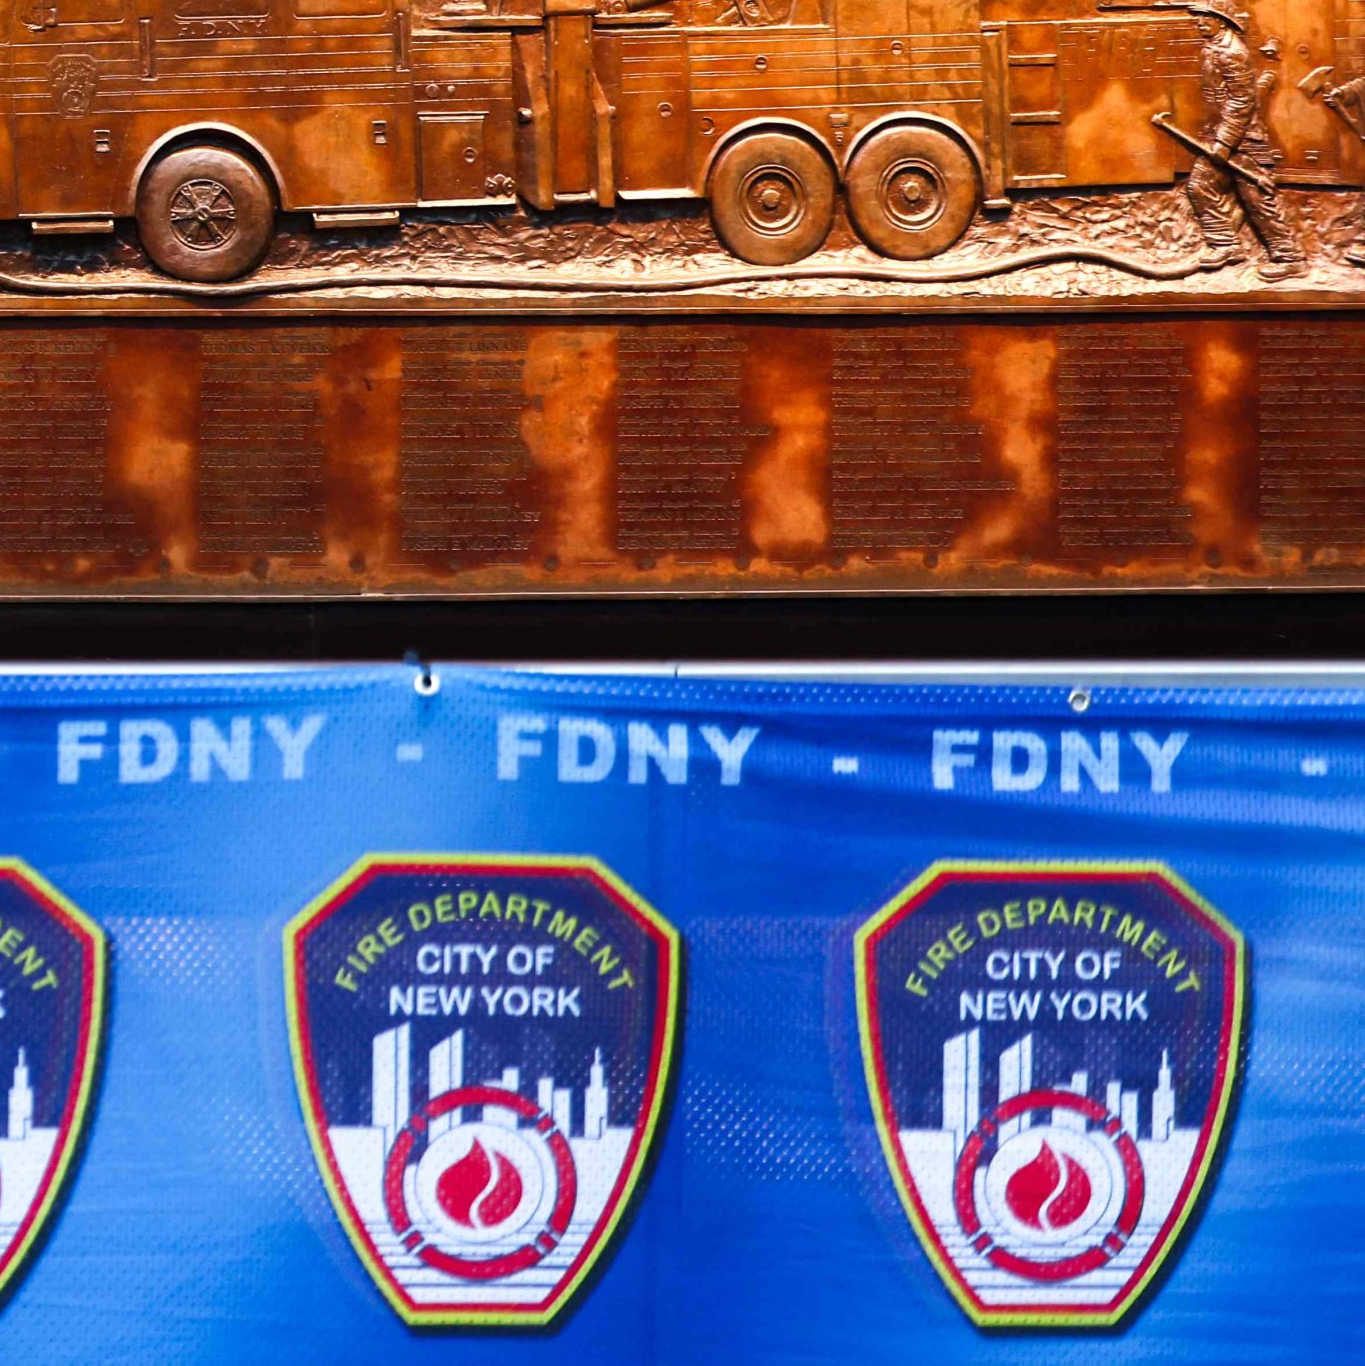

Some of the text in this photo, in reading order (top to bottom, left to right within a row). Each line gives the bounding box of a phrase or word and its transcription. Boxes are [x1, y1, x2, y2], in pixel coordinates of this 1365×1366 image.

[56, 716, 326, 783] FDNY
[496, 714, 760, 785] FDNY
[930, 730, 1190, 793] FDNY
[334, 890, 634, 993] FIRE DEPARTMENT
[905, 897, 1202, 998] FIRE DEPARTMENT
[416, 943, 556, 975] CITY OF
[985, 950, 1122, 980] CITY OF
[389, 986, 581, 1017] NEW YORK
[959, 990, 1149, 1022] NEW YORK
